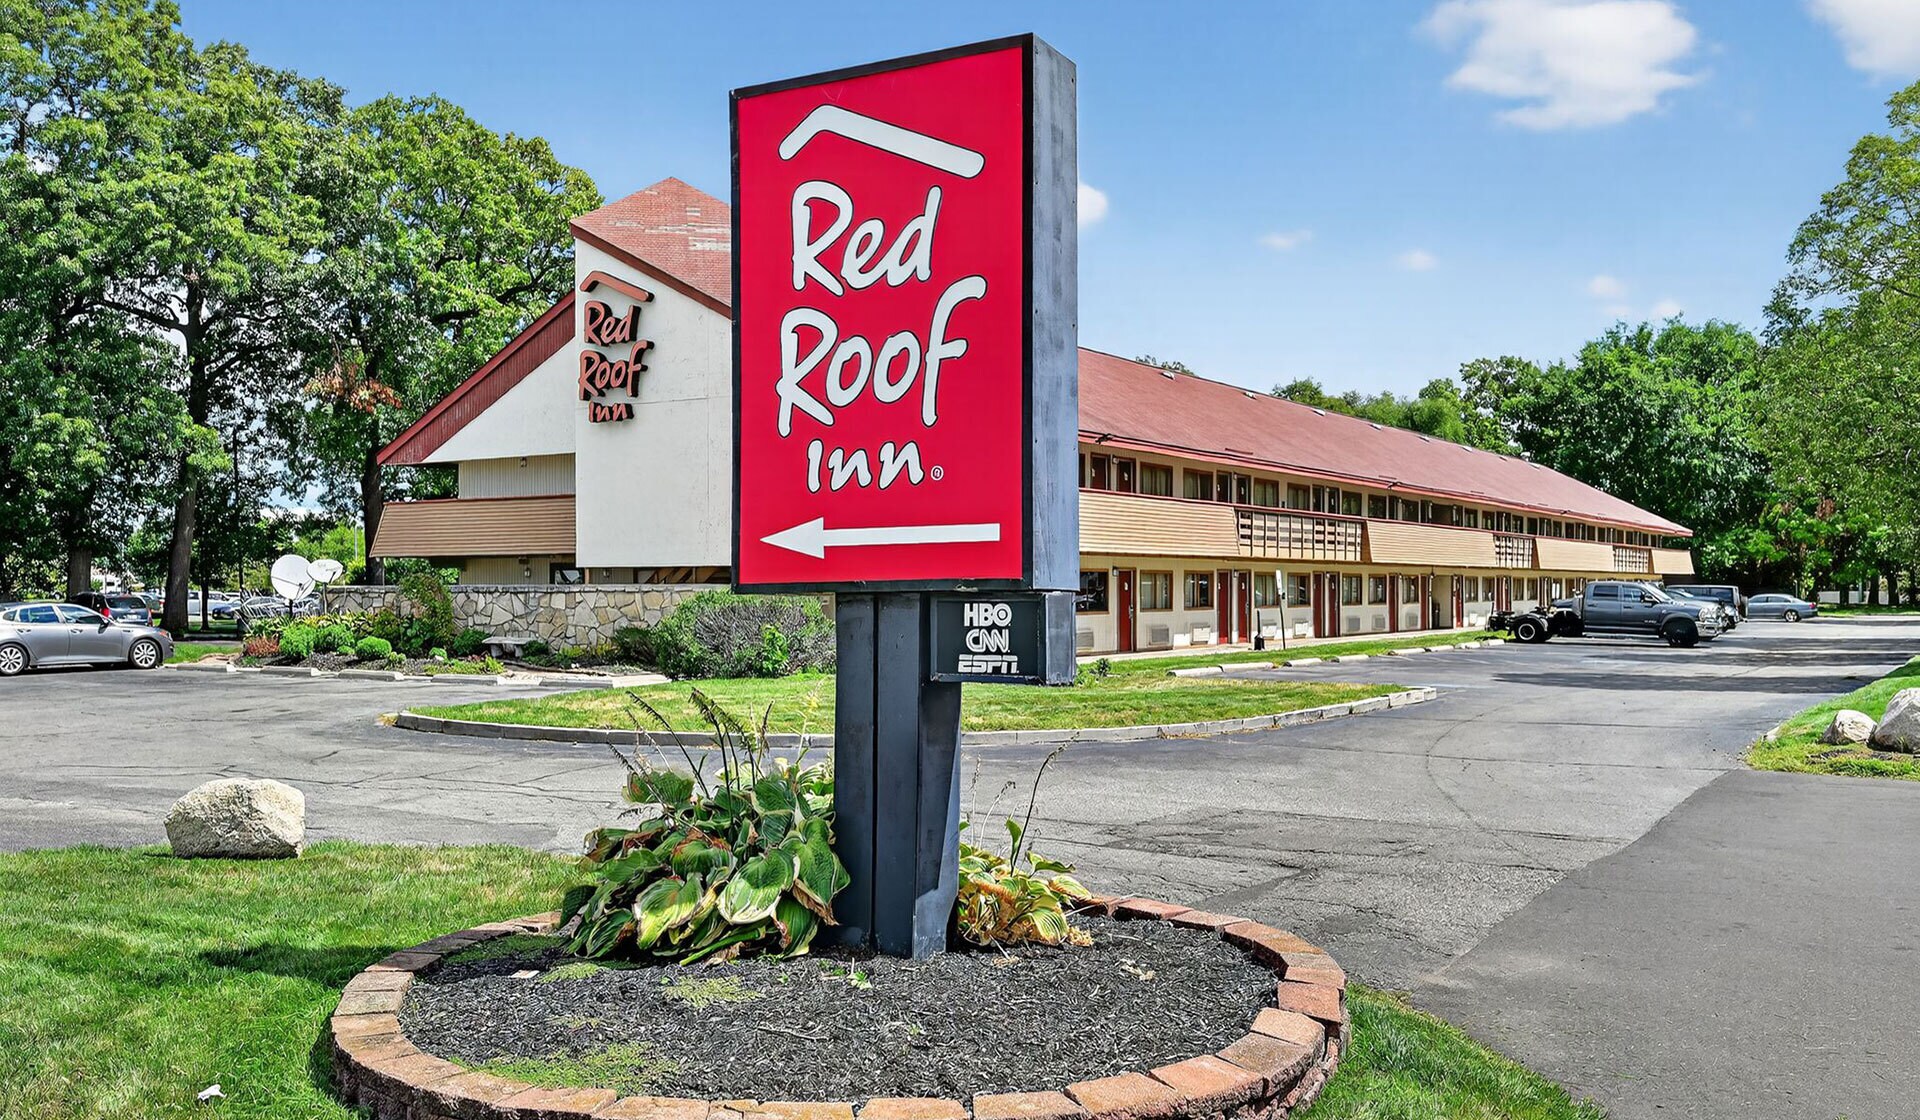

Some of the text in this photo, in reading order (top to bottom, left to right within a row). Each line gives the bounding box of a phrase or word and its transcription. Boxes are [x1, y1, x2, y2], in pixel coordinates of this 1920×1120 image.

[791, 180, 942, 297] Red
[584, 301, 641, 346] Red
[578, 340, 654, 401] Roof
[776, 275, 988, 438] Roof
[588, 401, 634, 423] Inn
[806, 438, 926, 494] Inn
[963, 602, 1012, 627] HBO
[965, 628, 1010, 653] CNN
[957, 654, 1019, 674] ESPN
